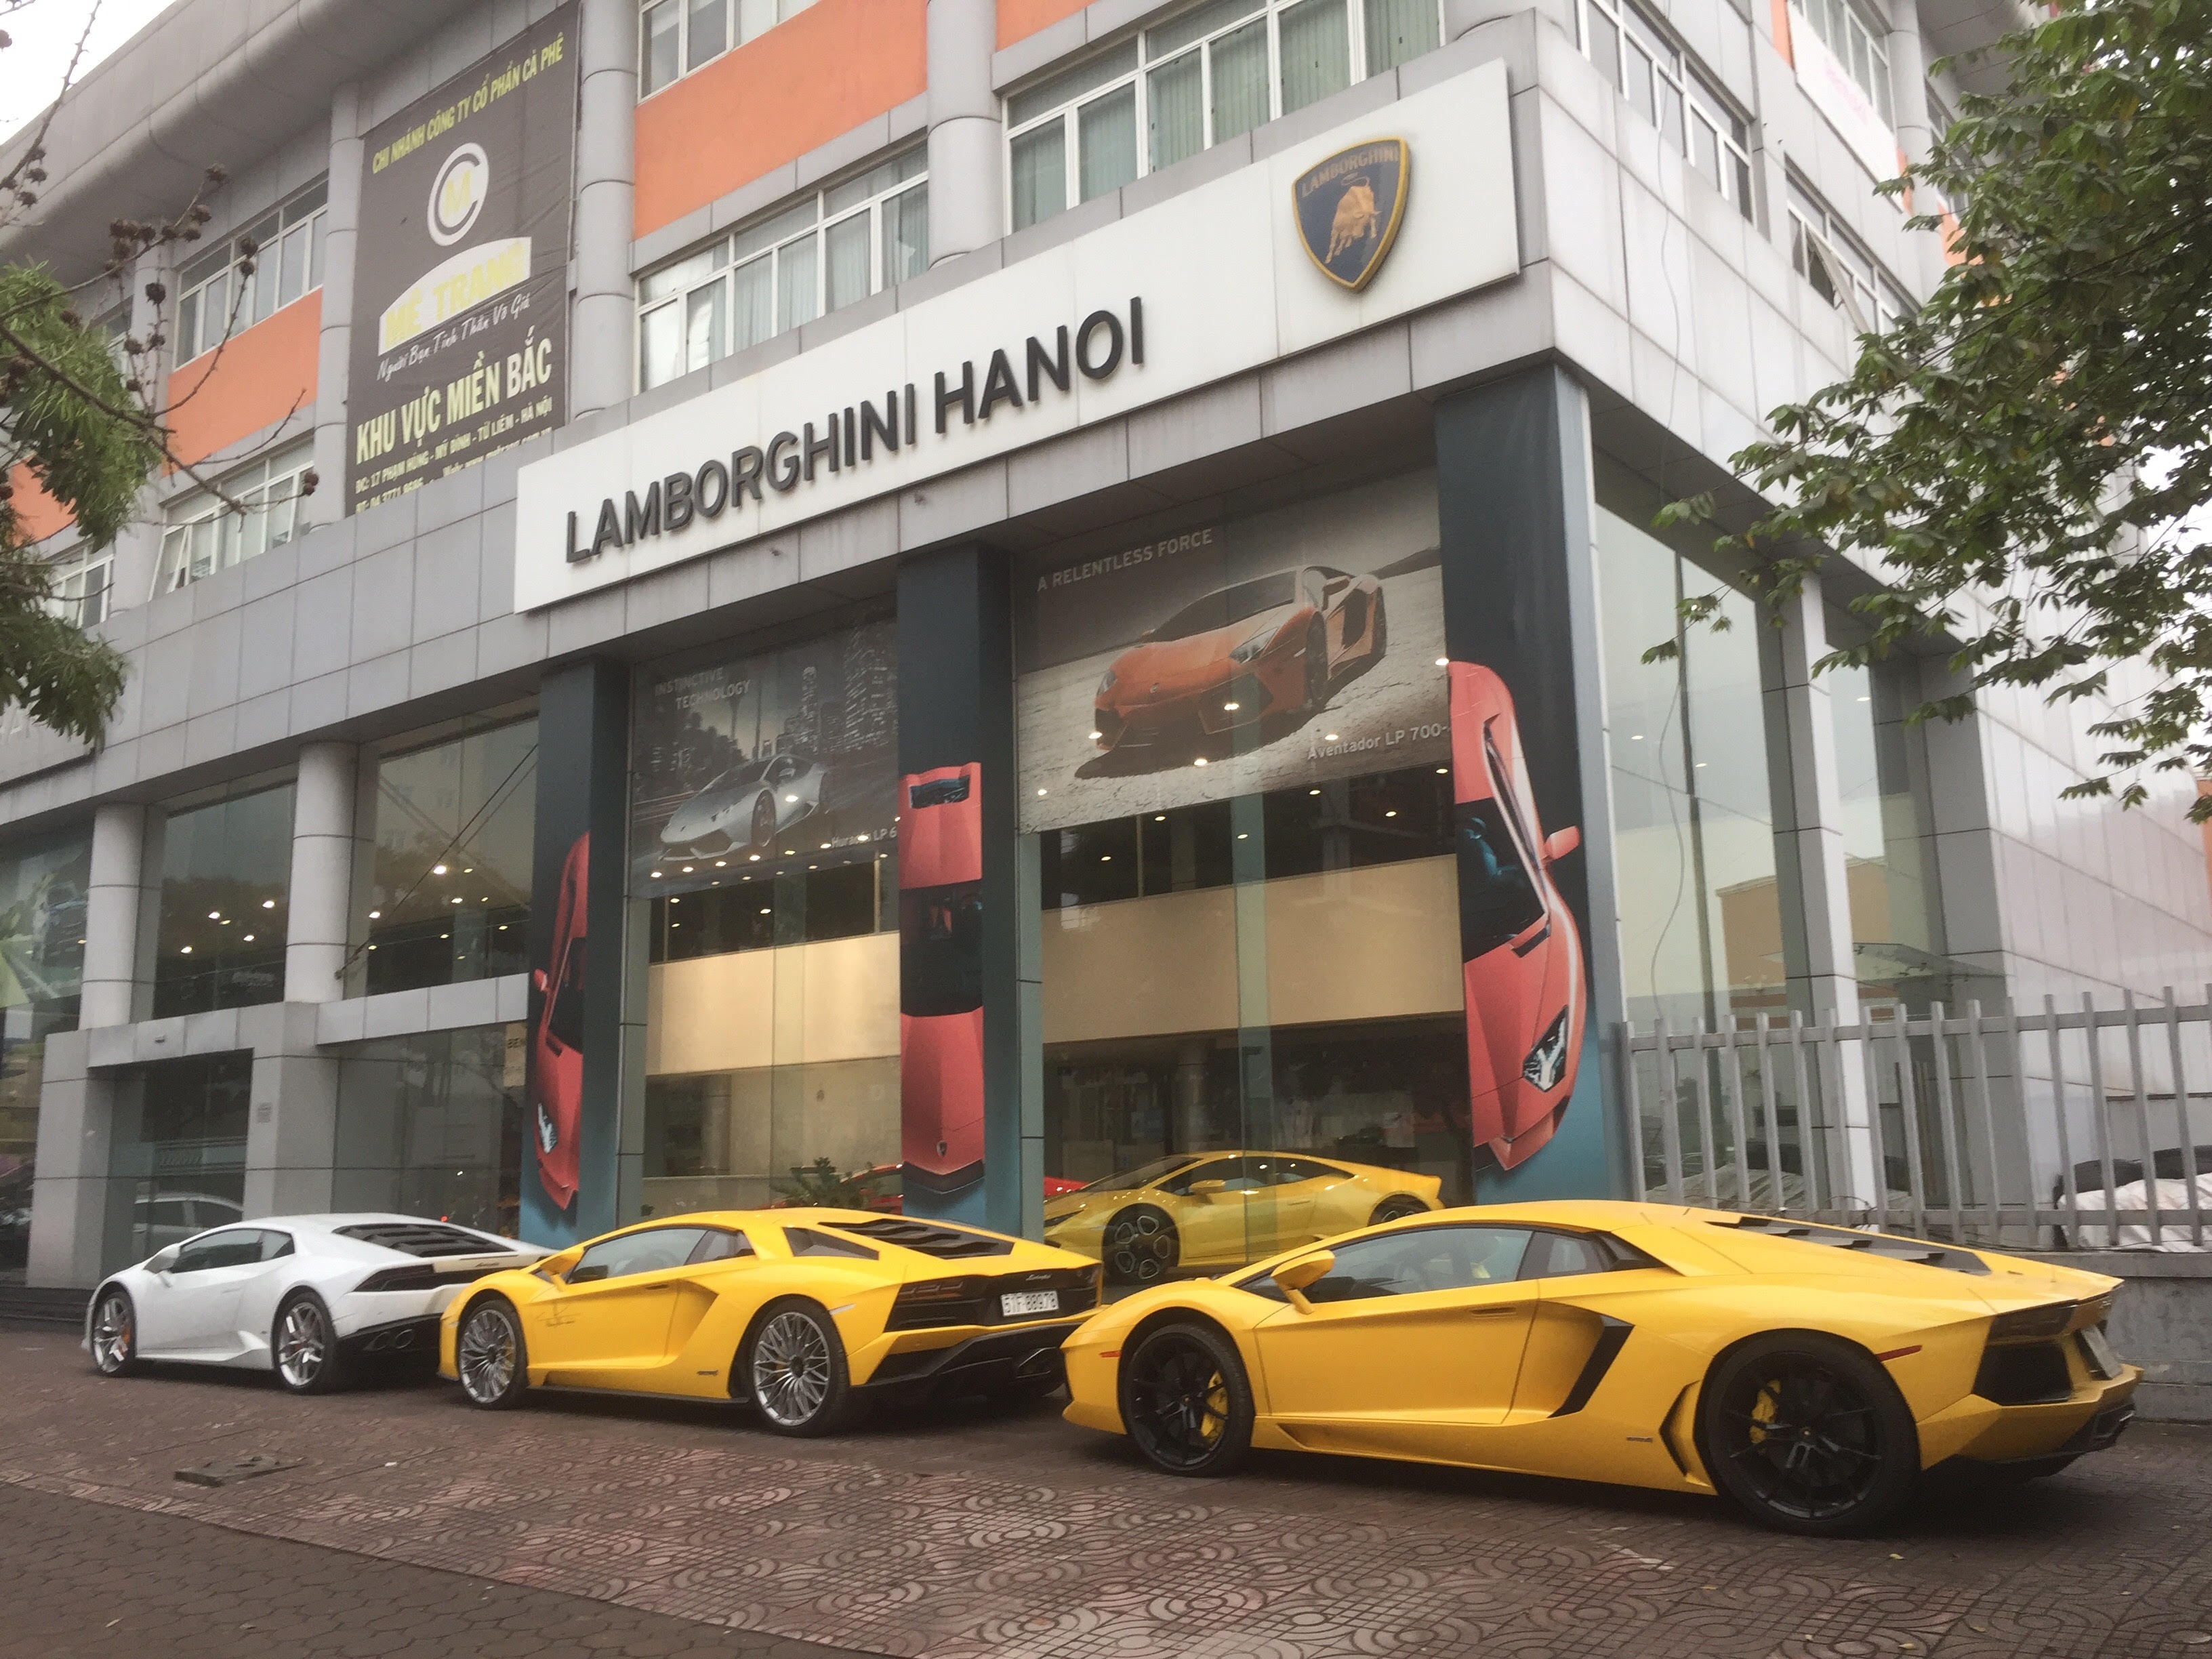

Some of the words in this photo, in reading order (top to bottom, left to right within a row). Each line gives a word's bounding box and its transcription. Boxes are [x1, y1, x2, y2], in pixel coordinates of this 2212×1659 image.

[427, 106, 455, 141] CÔNG
[457, 96, 472, 122] TY
[522, 49, 538, 82] CÀ
[540, 31, 565, 71] PHÊ
[1300, 146, 1399, 198] LAMBORGHINI
[356, 409, 396, 466] KHU
[401, 386, 441, 447] VỰC
[447, 350, 501, 426] MIỀN
[506, 325, 552, 398] BẮC
[567, 383, 916, 563] LAMBORGHINI
[935, 296, 1144, 434] HANOI
[1037, 577, 1048, 592] A
[1052, 546, 1153, 587] RELENTLESS
[1158, 528, 1213, 558] FORCE
[1307, 735, 1381, 760] Aventador
[1385, 729, 1406, 745] LP
[1410, 722, 1450, 741] 700-
